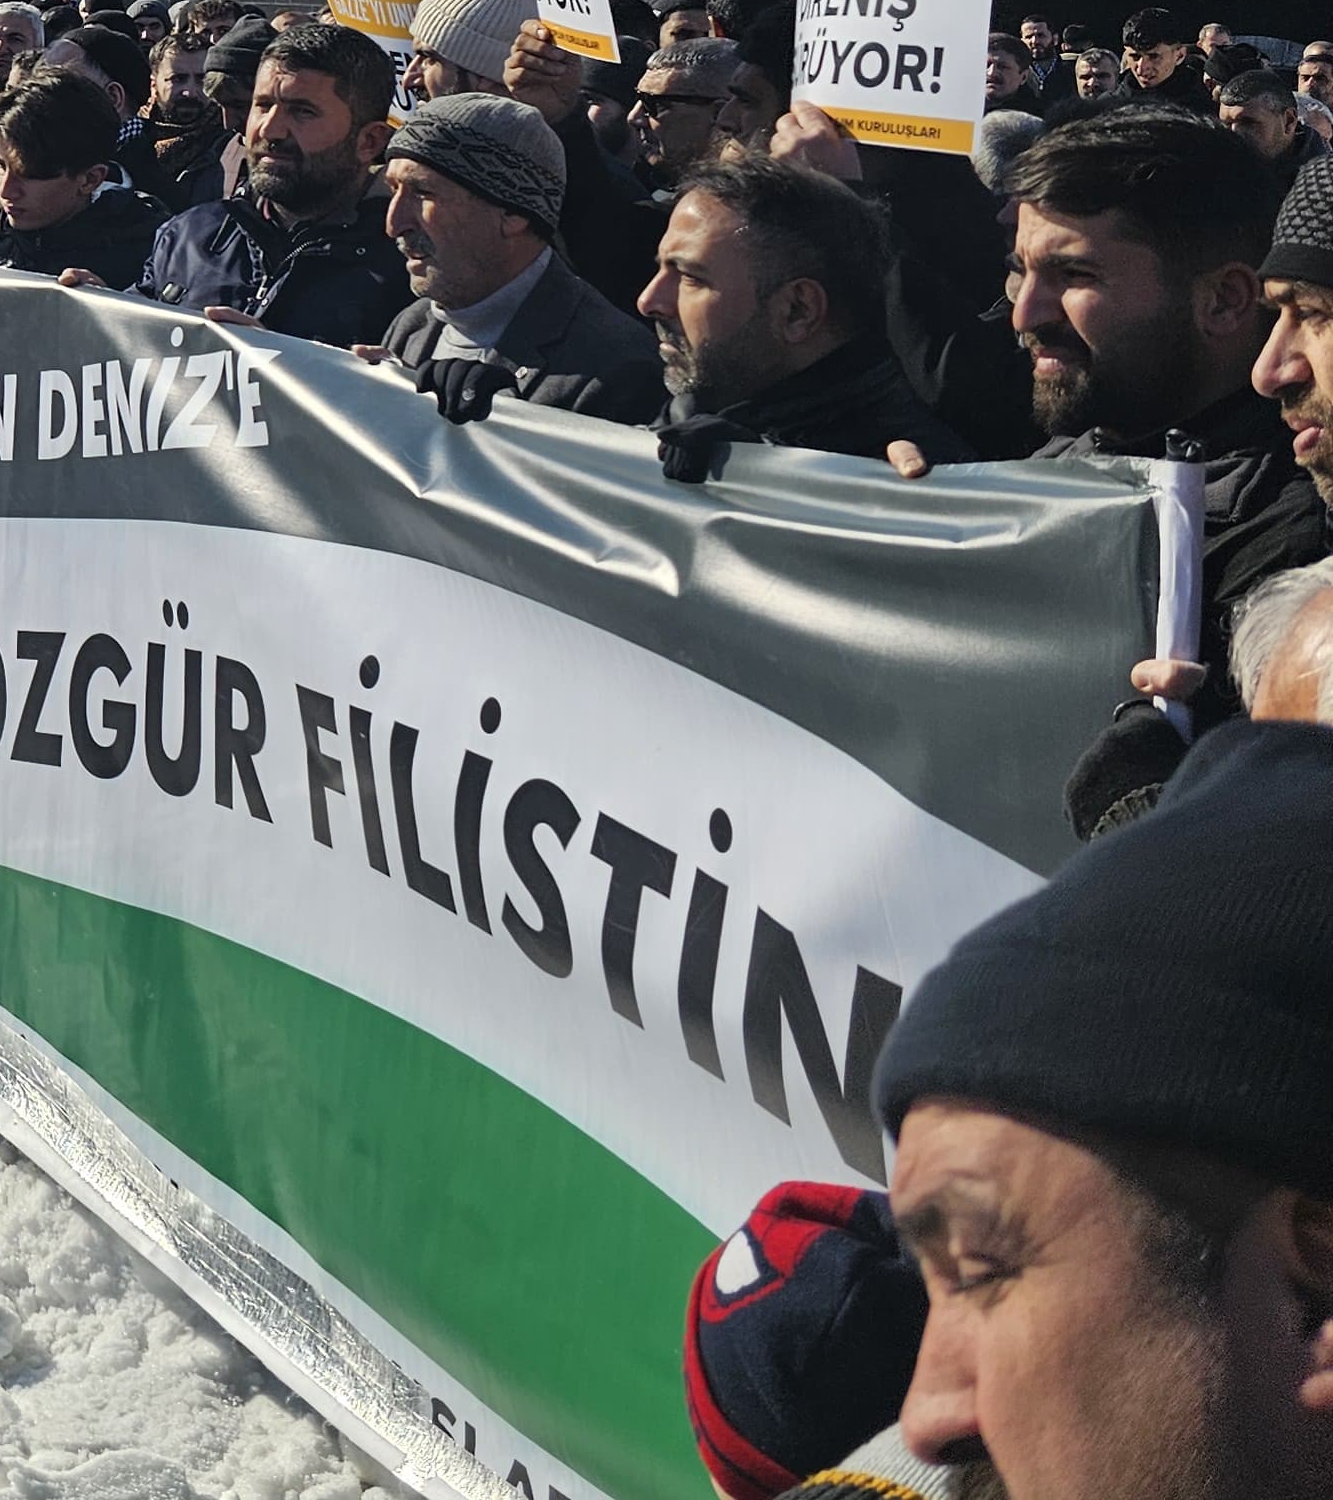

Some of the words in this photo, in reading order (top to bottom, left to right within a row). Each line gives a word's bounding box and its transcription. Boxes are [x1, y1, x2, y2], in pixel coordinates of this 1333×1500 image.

[857, 117, 942, 141] KURULUŞLARI
[37, 326, 282, 462] DENİZ'E
[294, 654, 904, 1188] FİLİSTİN
